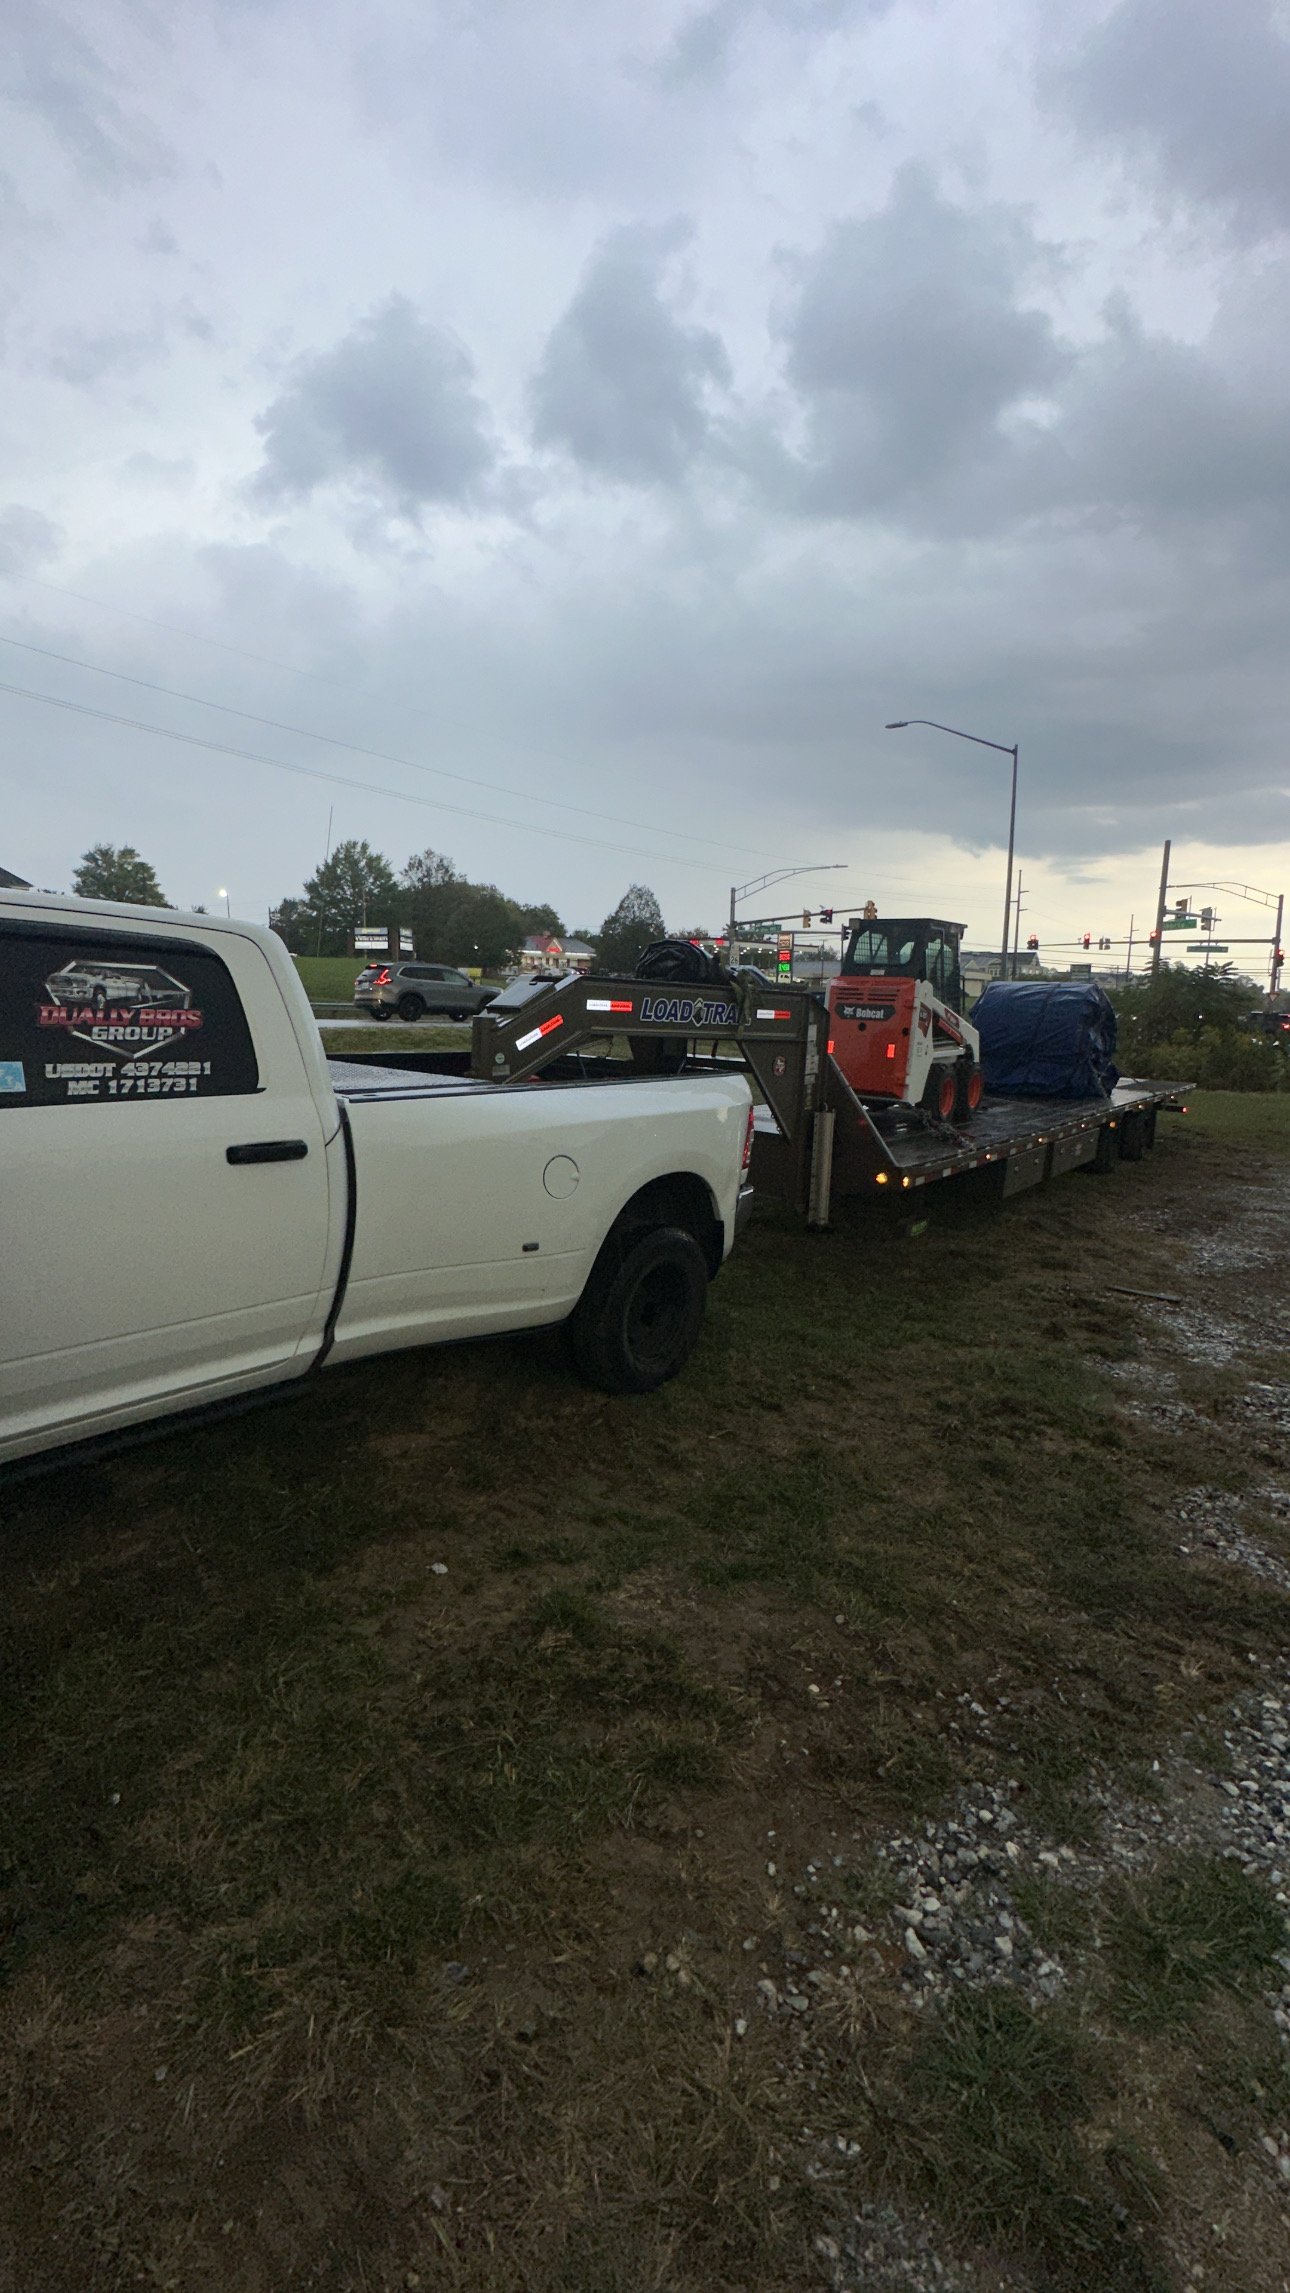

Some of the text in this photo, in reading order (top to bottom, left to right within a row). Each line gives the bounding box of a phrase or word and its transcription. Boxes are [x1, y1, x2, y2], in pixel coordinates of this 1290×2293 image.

[40, 1006, 203, 1026] DUALLY BROS
[640, 997, 694, 1022] LOAD
[703, 1001, 751, 1026] TRA
[856, 1008, 884, 1019] Bobcat
[92, 1026, 173, 1041] GROUP
[45, 1061, 211, 1078] USDOT 4374221
[67, 1078, 197, 1095] MC 1713731
